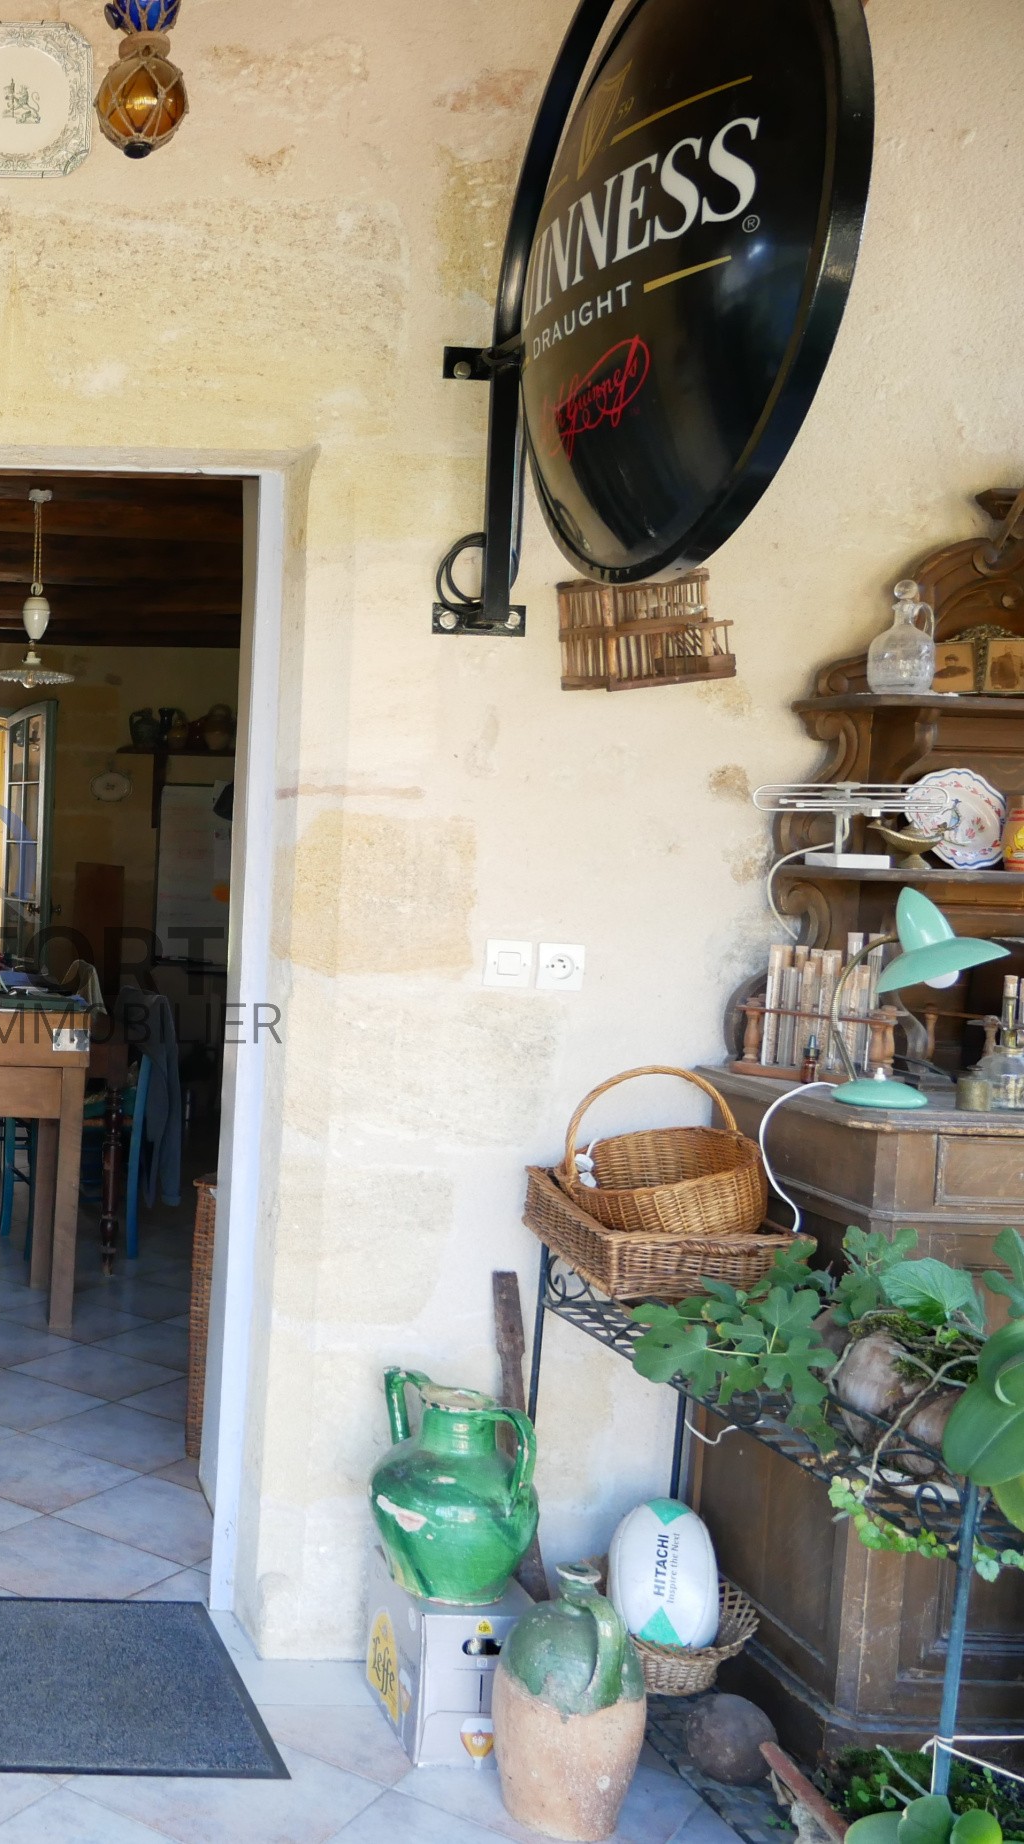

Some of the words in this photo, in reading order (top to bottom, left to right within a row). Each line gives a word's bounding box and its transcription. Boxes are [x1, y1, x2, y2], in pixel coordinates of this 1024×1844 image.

[523, 116, 760, 330] UINNESS
[533, 281, 632, 360] DRAUGHT
[653, 1534, 669, 1597] HITACHI
[670, 1553, 678, 1568] the
[671, 1532, 680, 1552] Next
[666, 1570, 678, 1603] Inspire
[371, 1637, 395, 1695] Leffe
